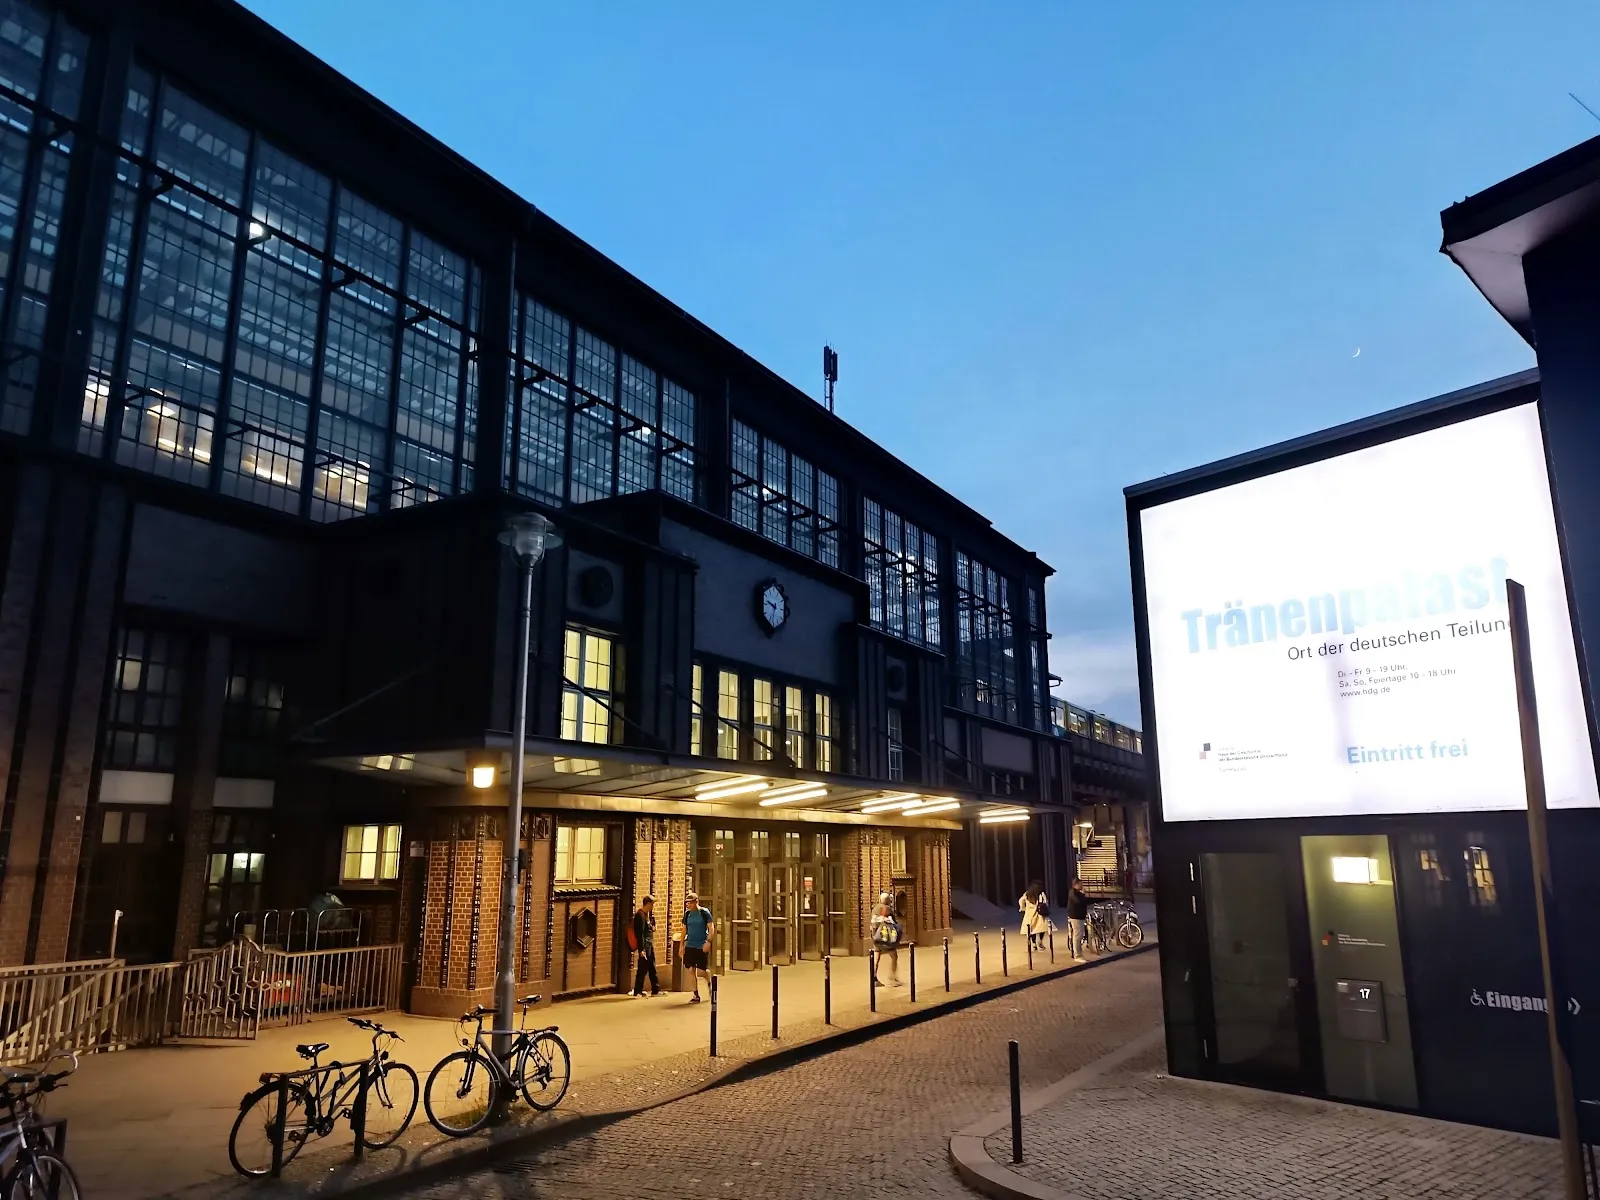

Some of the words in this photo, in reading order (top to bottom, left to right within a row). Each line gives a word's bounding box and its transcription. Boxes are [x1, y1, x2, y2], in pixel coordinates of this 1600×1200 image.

[1181, 556, 1508, 653] Tränenpalast
[1288, 646, 1313, 660] Ort
[1318, 642, 1344, 656] der
[1350, 629, 1441, 652] deutschen
[1446, 619, 1511, 638] Teilun
[1354, 668, 1363, 676] Fr
[1365, 667, 1371, 675] 9
[1379, 665, 1388, 673] 19
[1368, 674, 1407, 684] Feiertage
[1410, 671, 1420, 679] 10
[1428, 669, 1438, 678] 18
[1440, 668, 1457, 676] Uhr
[1340, 686, 1391, 698] www.hdg.de
[1347, 743, 1424, 764] Eintritt
[1430, 738, 1468, 759] frei
[1359, 988, 1371, 1000] 17
